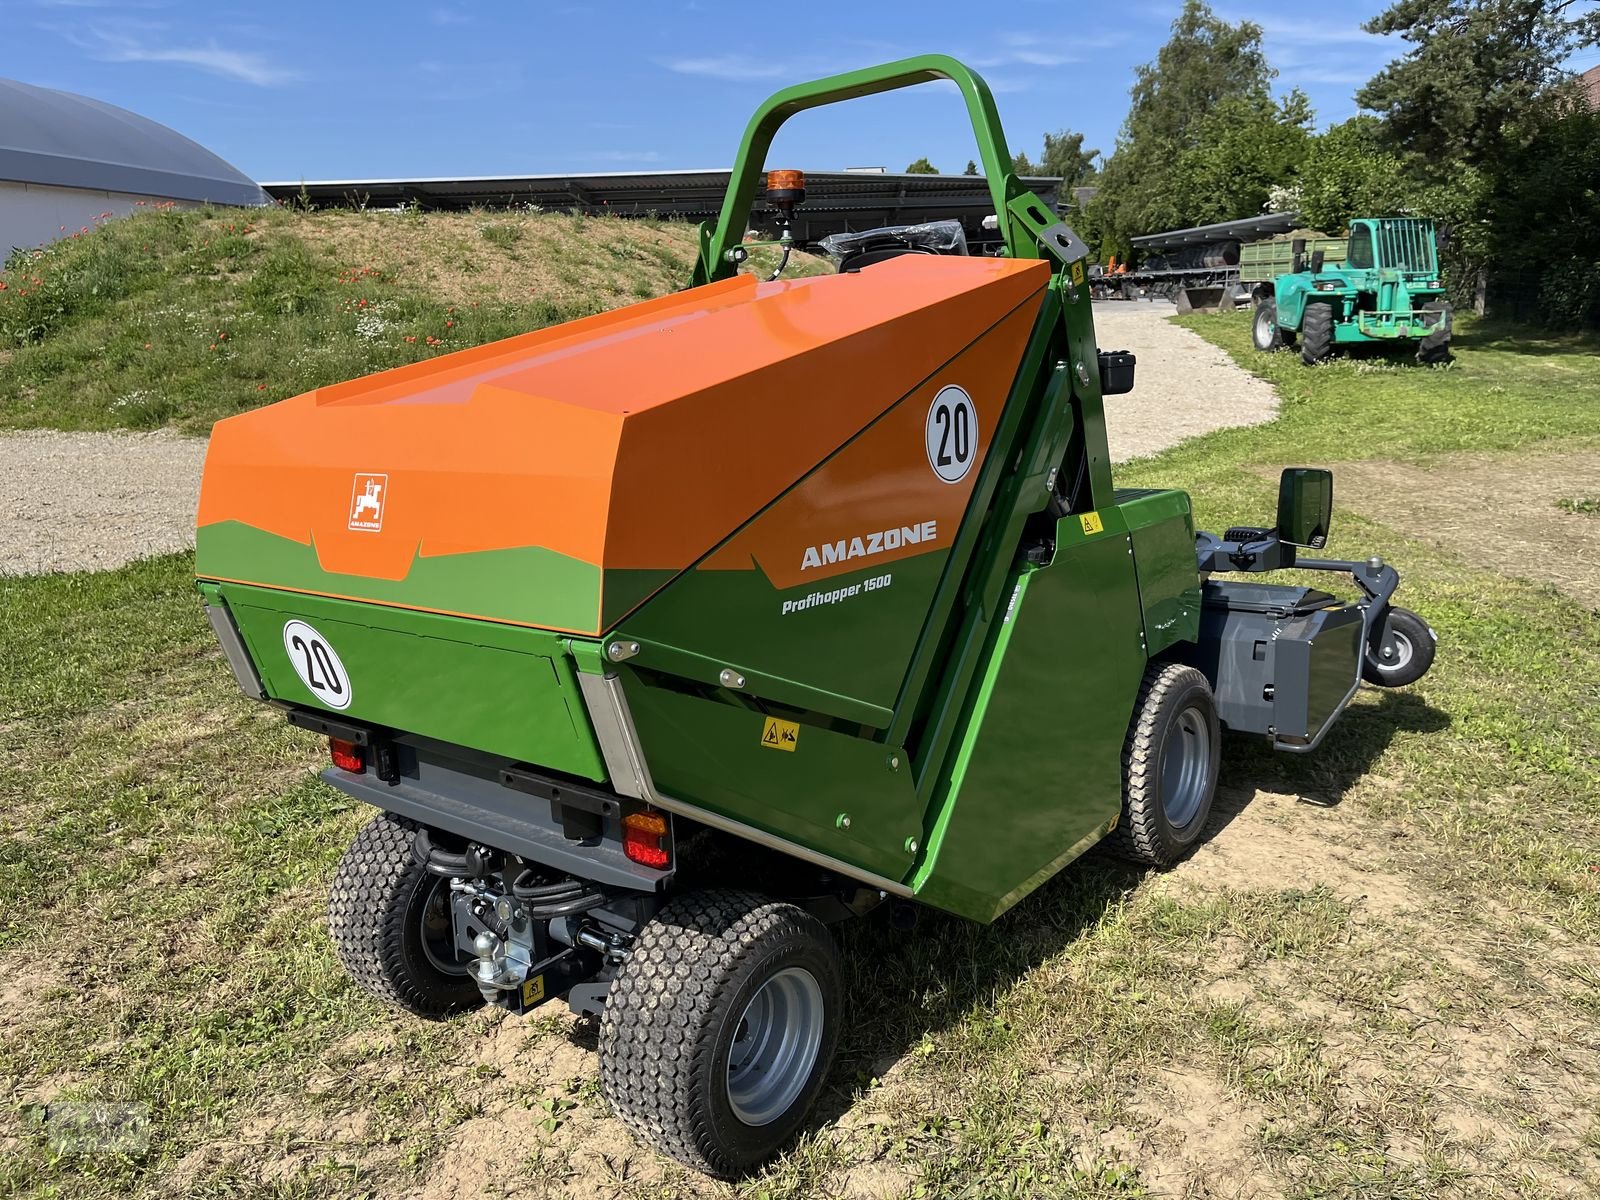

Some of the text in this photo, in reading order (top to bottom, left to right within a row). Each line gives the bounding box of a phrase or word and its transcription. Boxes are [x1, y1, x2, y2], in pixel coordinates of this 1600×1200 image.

[936, 402, 968, 467] 20
[800, 520, 937, 571] AMAZONE
[782, 573, 892, 615] Profihopper 1500
[292, 635, 342, 694] 20
